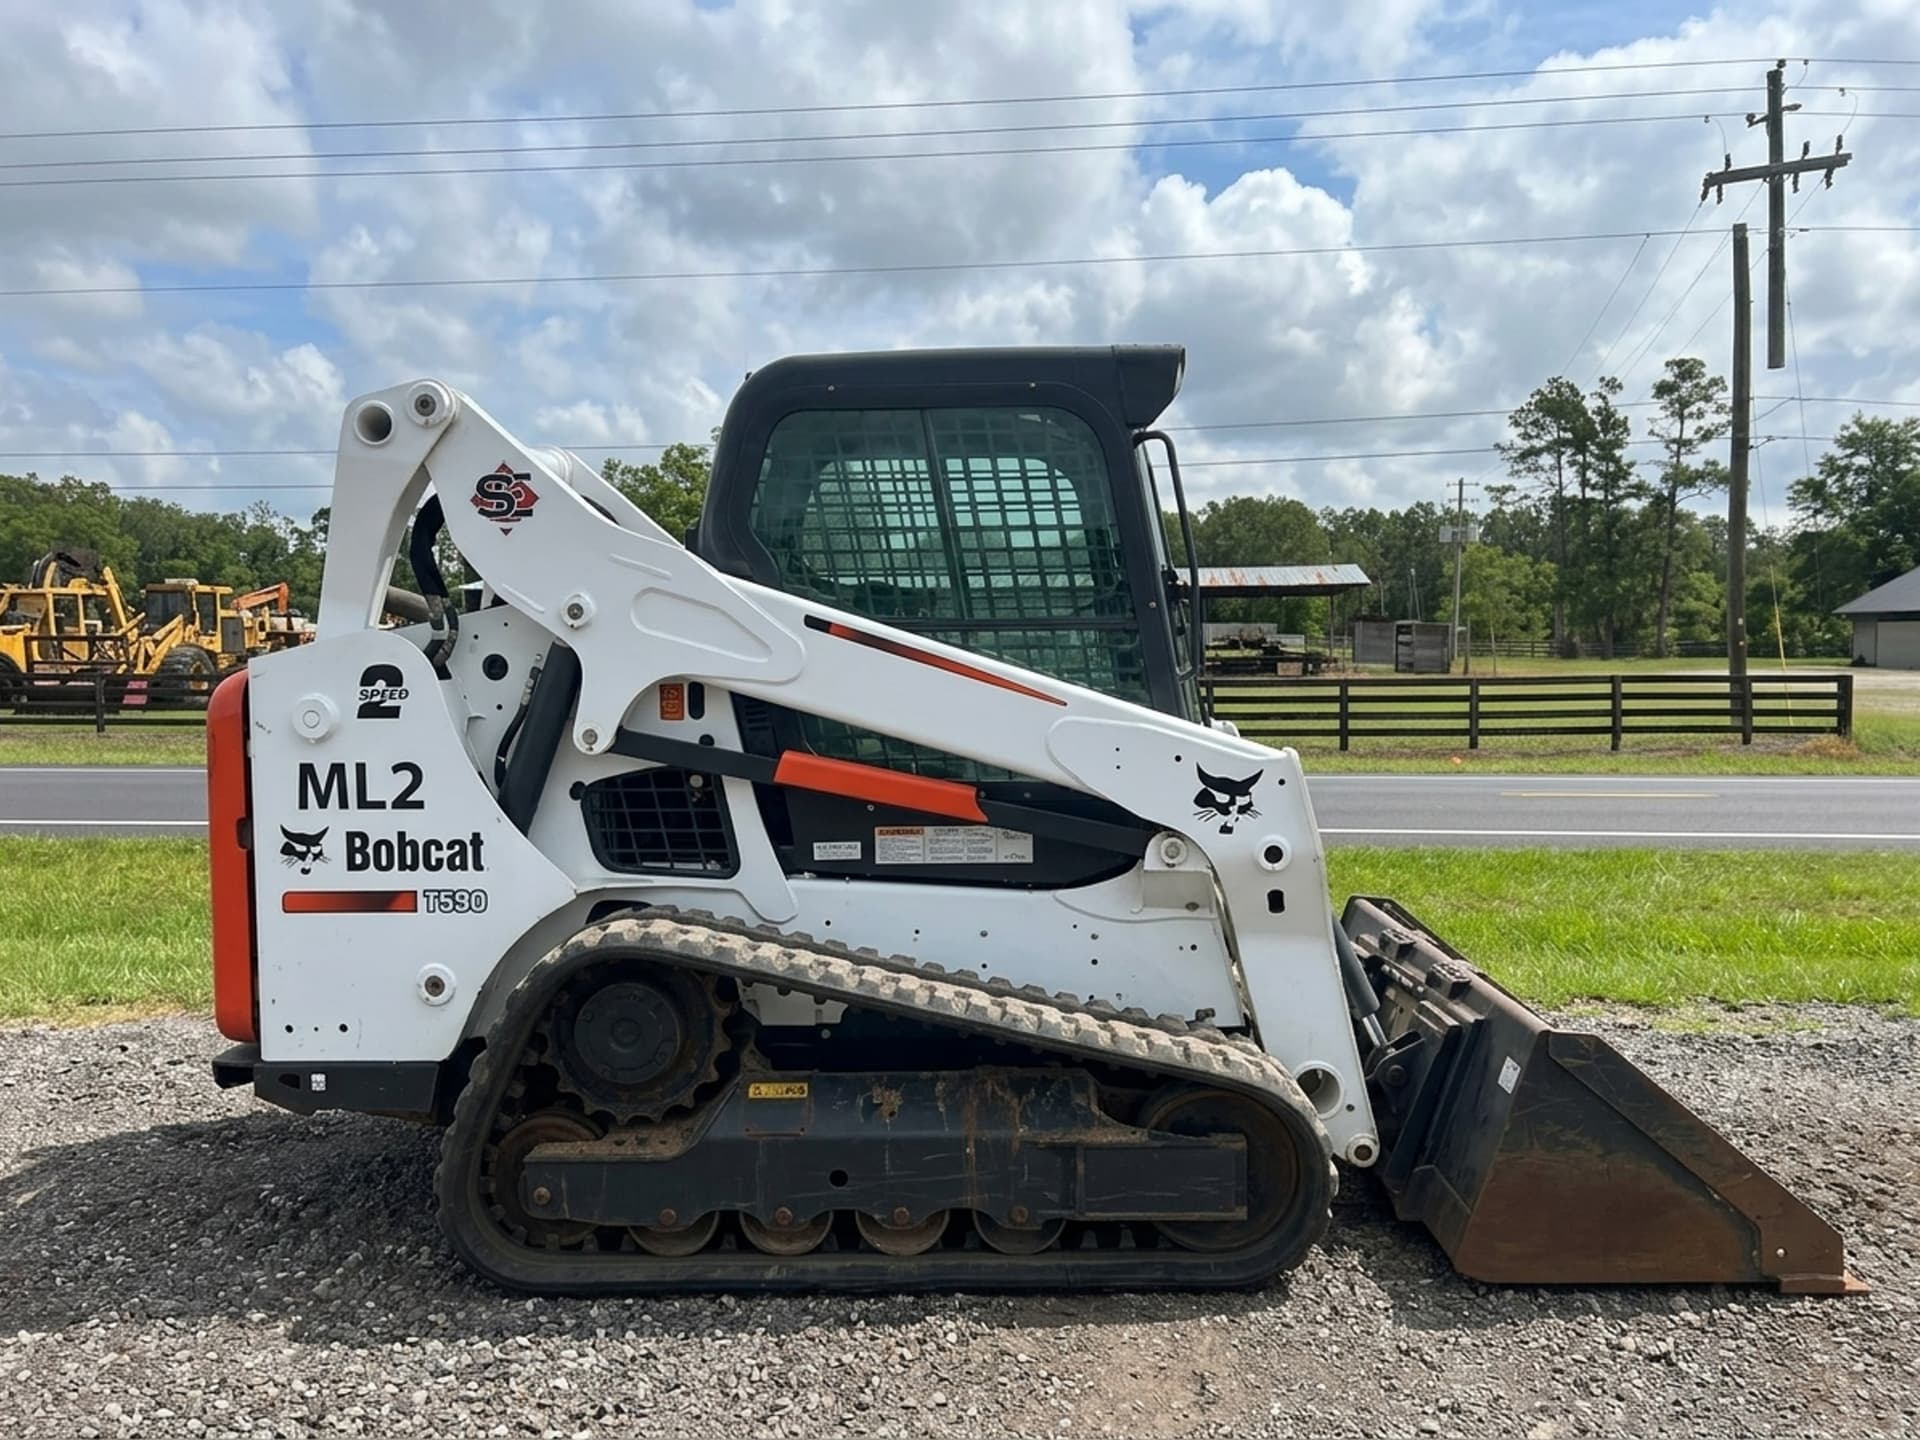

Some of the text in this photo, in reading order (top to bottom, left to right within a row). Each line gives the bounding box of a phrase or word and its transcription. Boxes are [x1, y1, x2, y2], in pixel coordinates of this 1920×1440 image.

[358, 688, 409, 701] SPEED
[299, 762, 425, 810] ML2
[346, 831, 484, 872] Bobcat
[422, 889, 488, 913] T590
